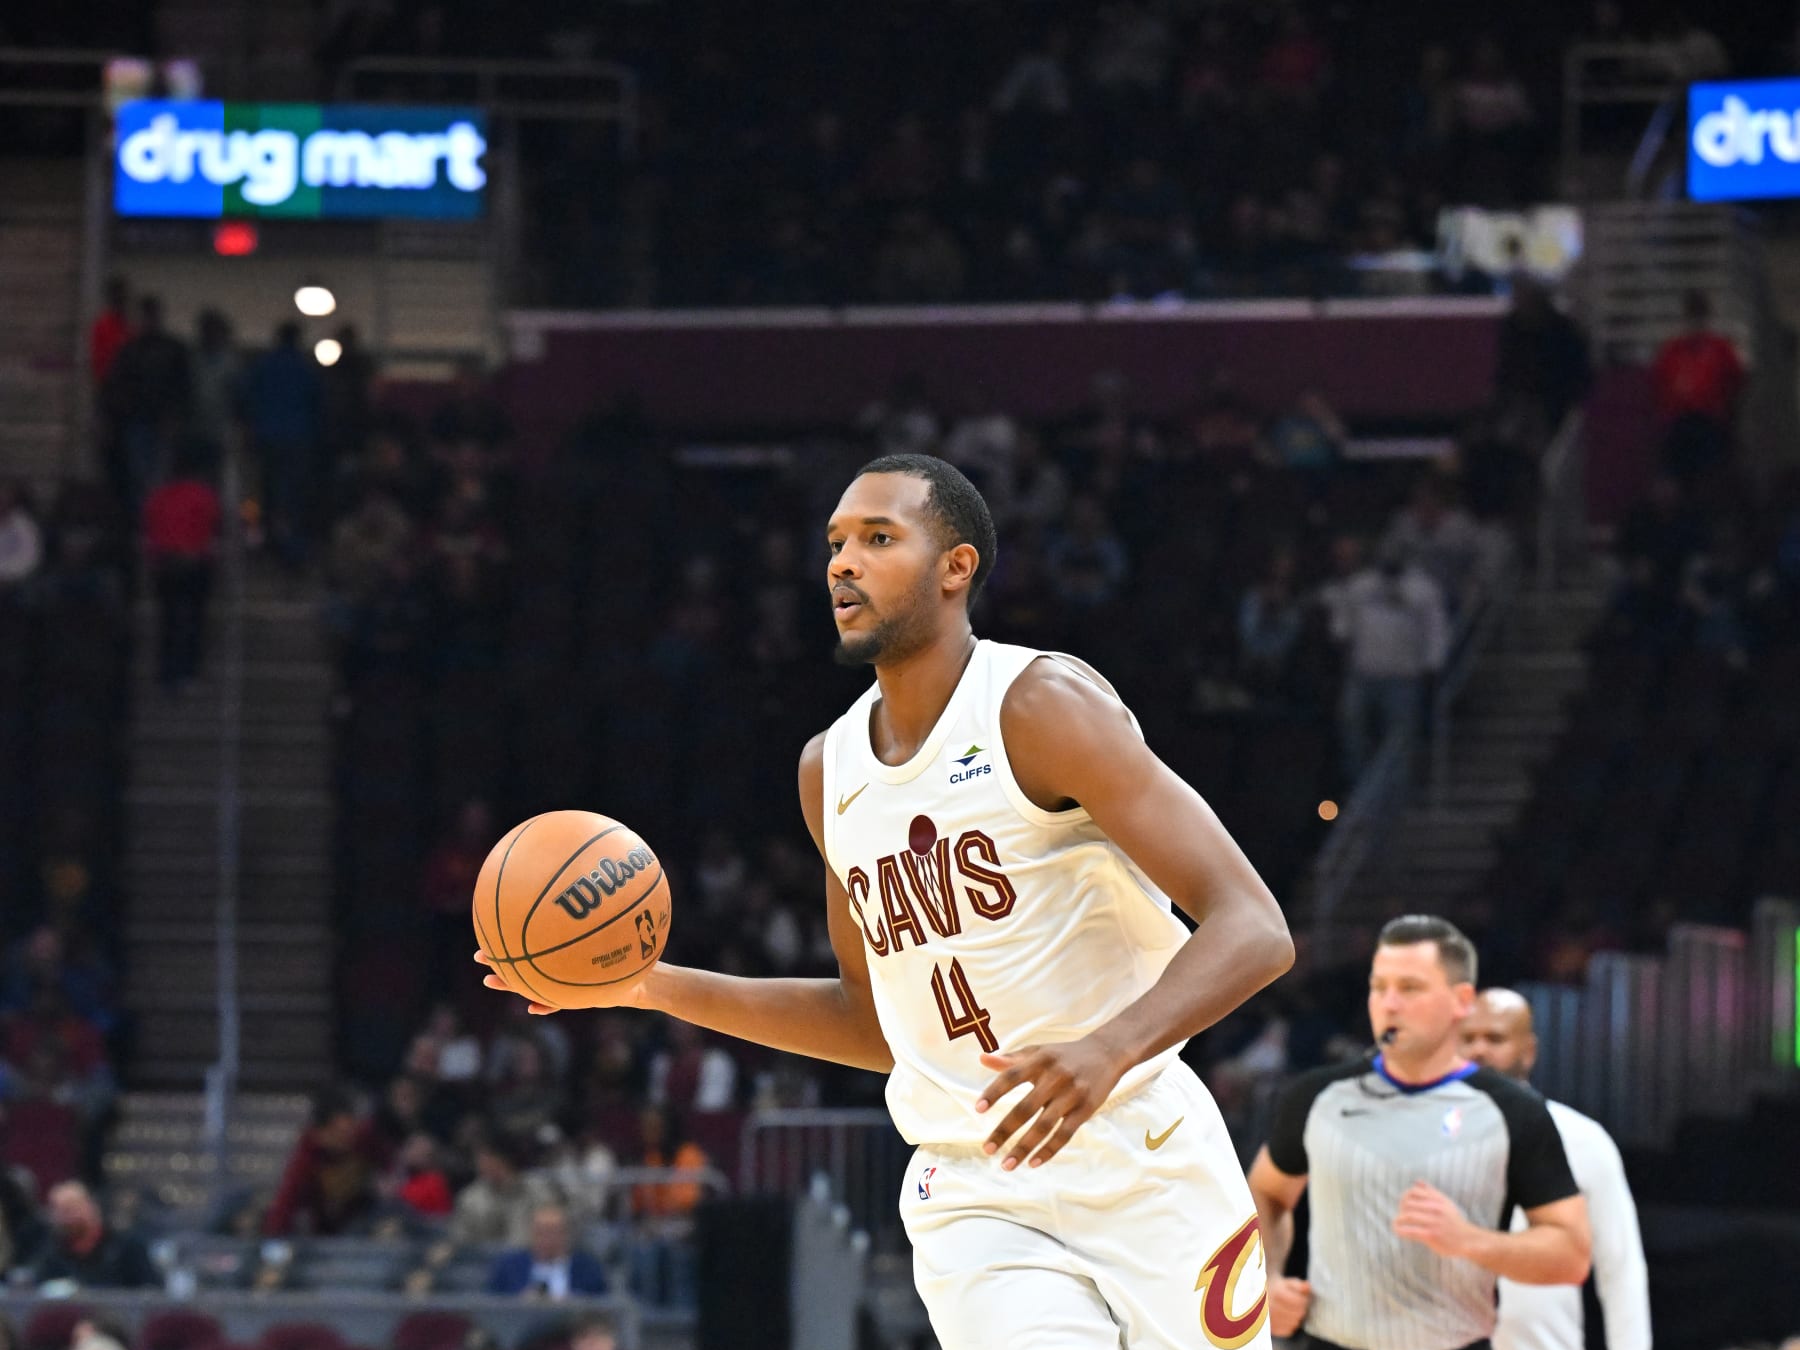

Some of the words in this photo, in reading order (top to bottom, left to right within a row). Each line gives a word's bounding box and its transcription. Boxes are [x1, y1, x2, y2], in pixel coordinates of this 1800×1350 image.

[119, 112, 299, 205] drug
[301, 120, 486, 192] mart
[949, 764, 992, 784] CLIFFS
[553, 843, 656, 920] Wilson
[847, 829, 1017, 957] CAVS
[930, 956, 1000, 1054] 4
